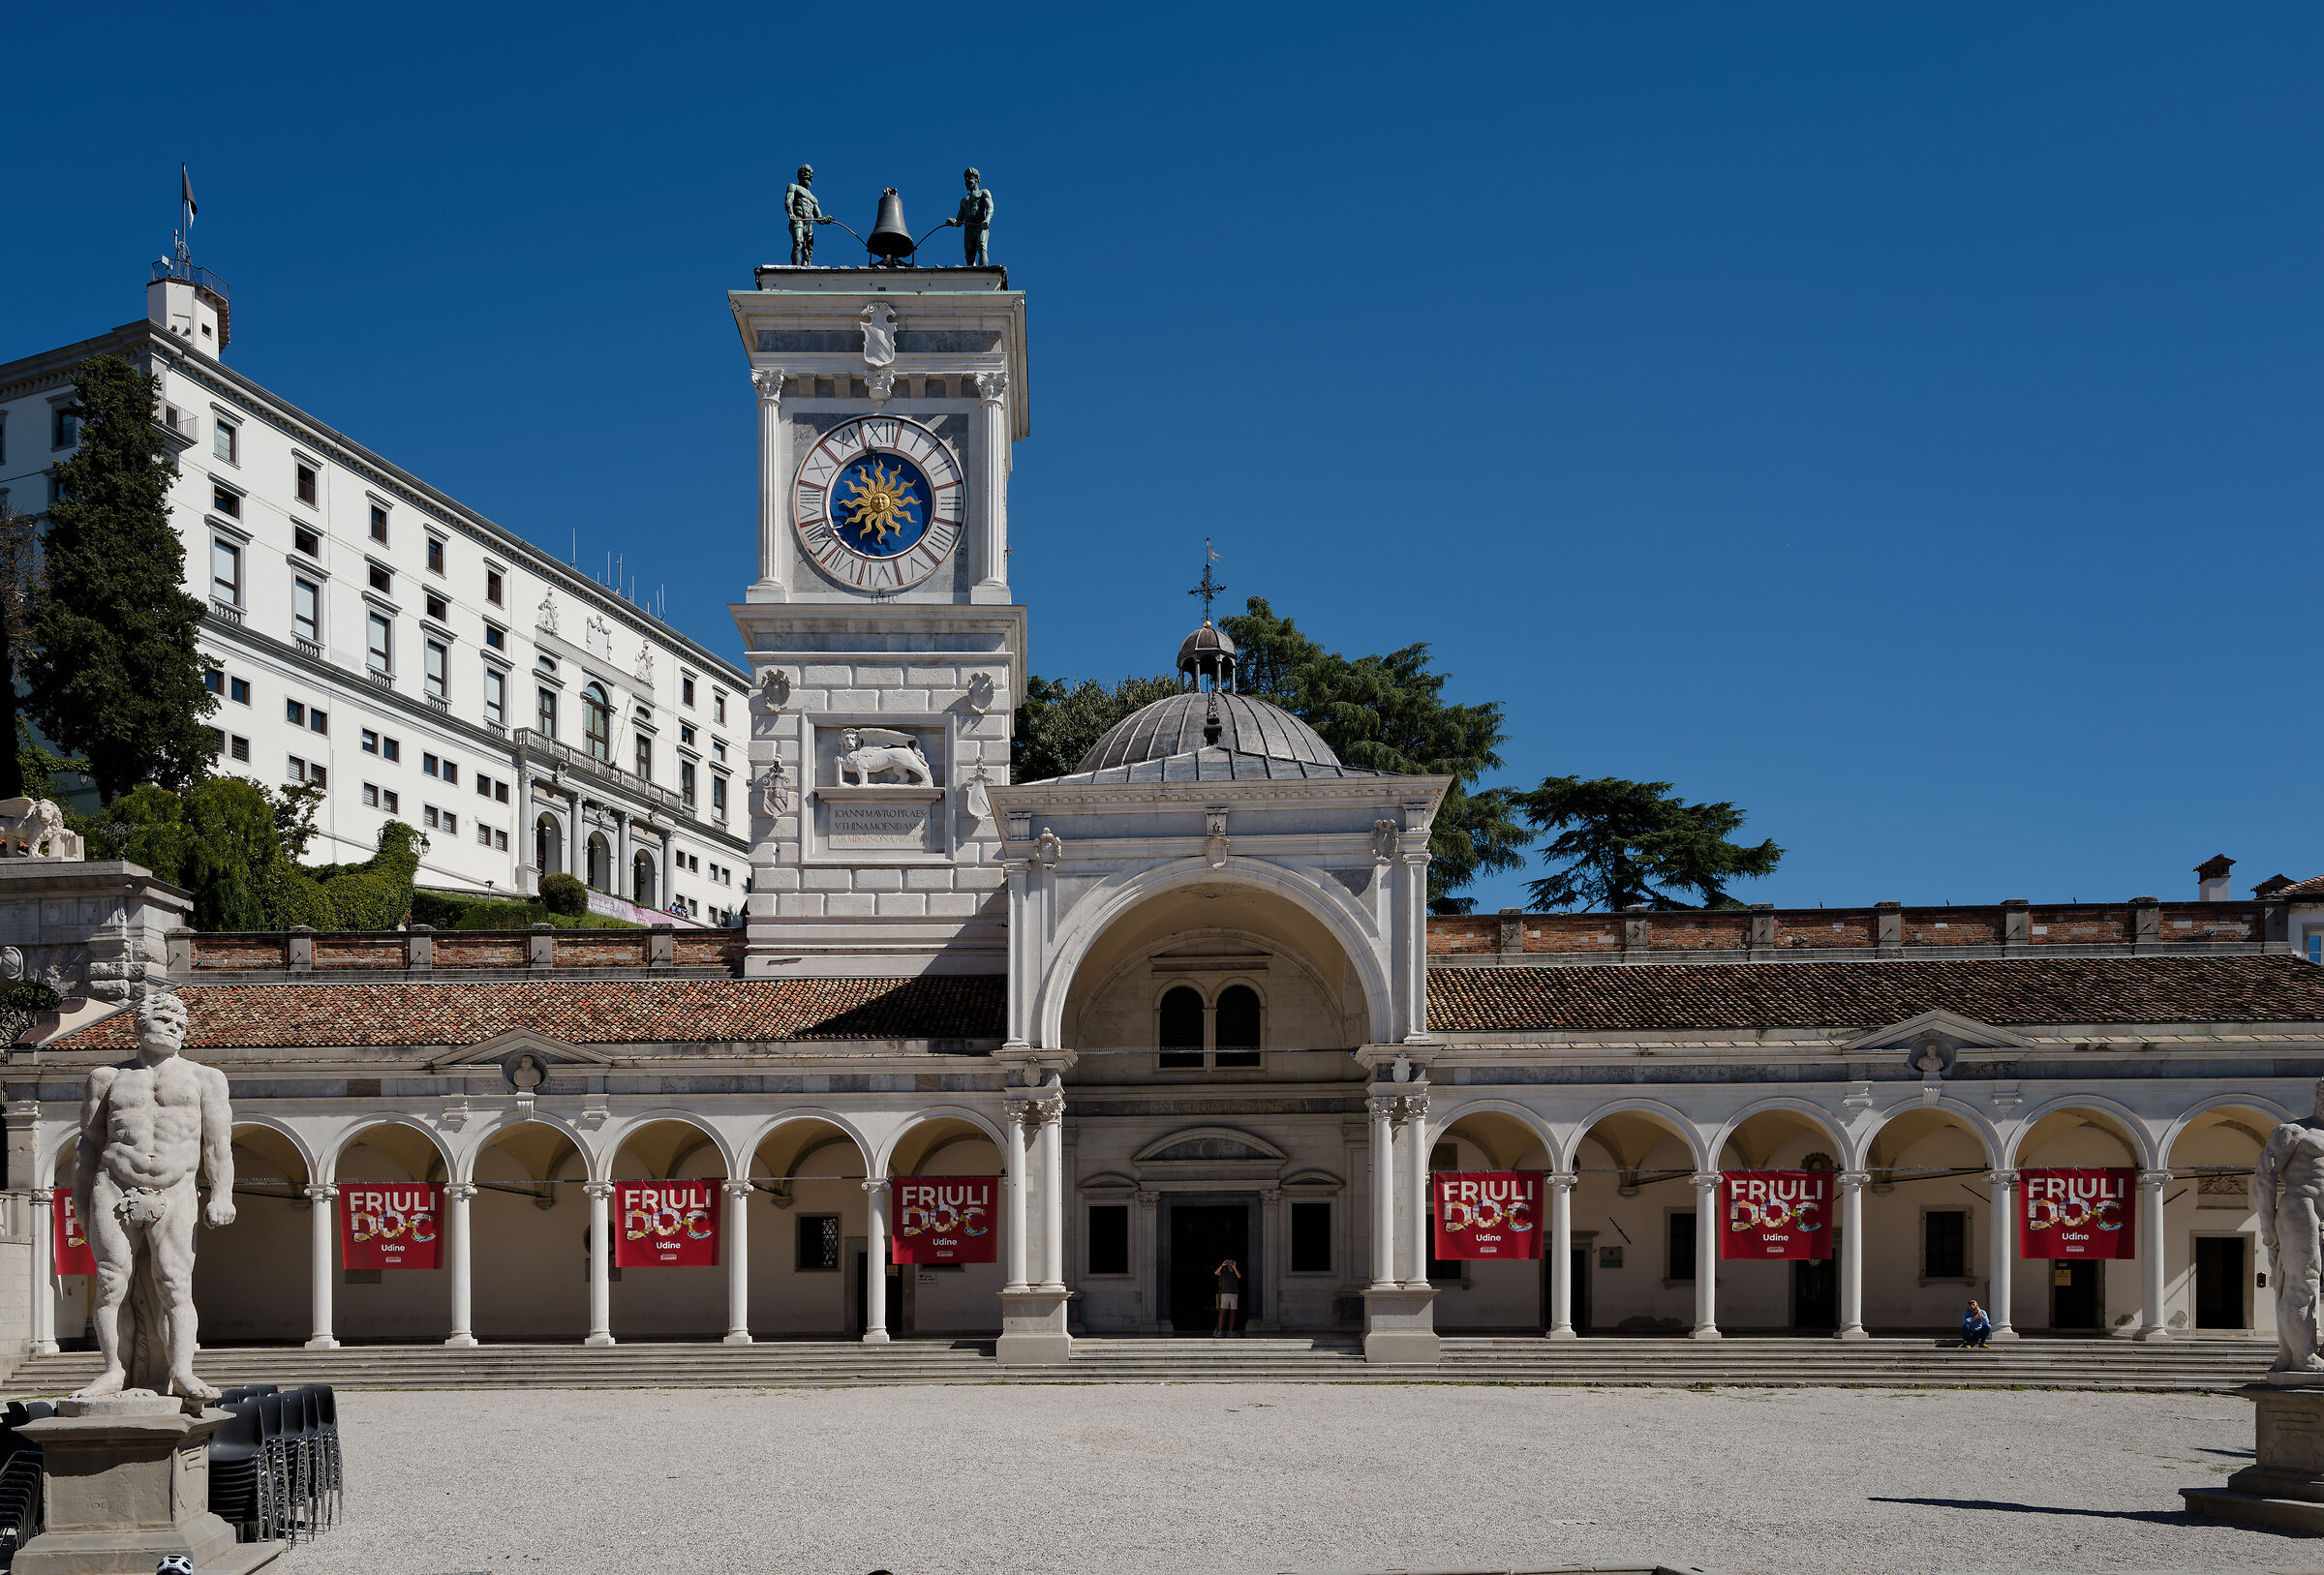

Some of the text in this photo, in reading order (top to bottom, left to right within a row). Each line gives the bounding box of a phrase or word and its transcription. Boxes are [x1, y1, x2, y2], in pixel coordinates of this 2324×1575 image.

[832, 429, 859, 455] XI
[867, 422, 895, 442] XII
[910, 433, 922, 451] I
[808, 457, 832, 479] X
[932, 460, 952, 476] II
[830, 552, 854, 584] VII
[869, 564, 893, 587] VI
[835, 809, 865, 818] IOANNI
[865, 809, 897, 818] MAVRO
[902, 1186, 988, 1205] FRIULI
[1444, 1181, 1533, 1200] FRIULI
[1731, 1180, 1822, 1199] FRIULI
[2029, 1178, 2124, 1198] FRIULI
[350, 1193, 435, 1211] FRIULI
[626, 1189, 711, 1209] FRIULI
[626, 1208, 712, 1240] DOC
[902, 1204, 988, 1236] DOC
[1444, 1199, 1533, 1231] DOC
[1730, 1199, 1821, 1231] DOC
[2029, 1196, 2123, 1231] DOC
[351, 1211, 436, 1242] DOC
